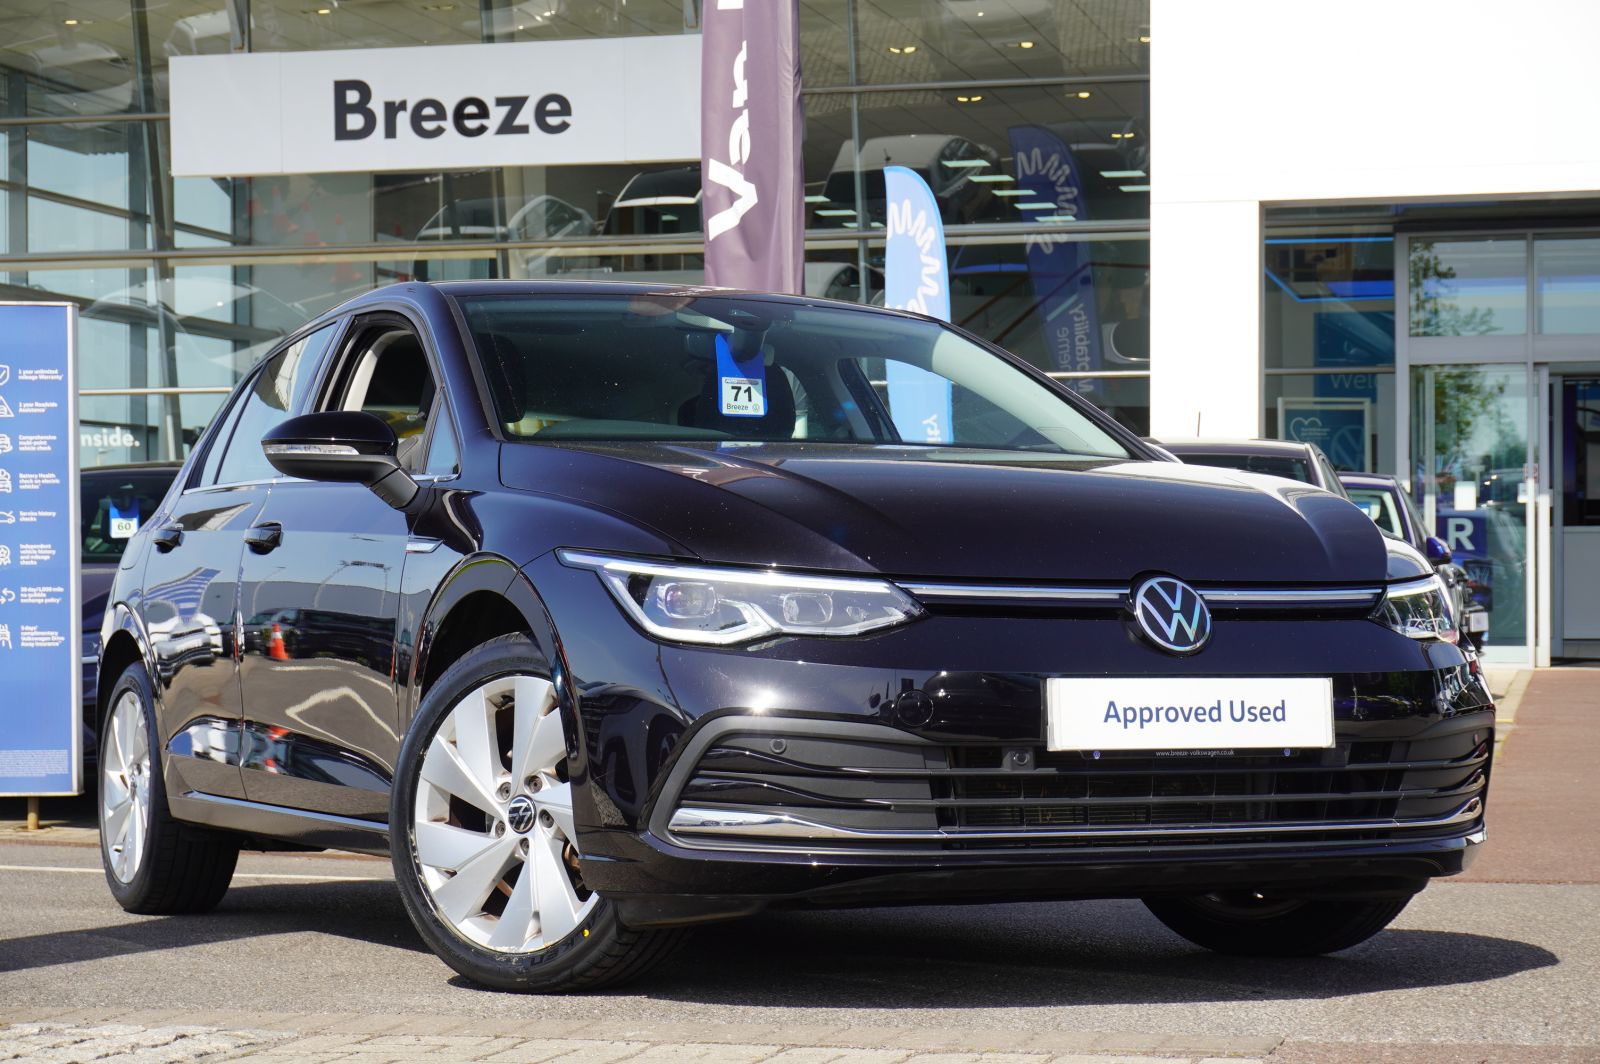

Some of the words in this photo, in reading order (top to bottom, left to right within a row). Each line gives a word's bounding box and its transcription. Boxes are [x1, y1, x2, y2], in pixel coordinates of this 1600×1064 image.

[334, 79, 572, 141] Breeze
[731, 386, 752, 402] 71
[726, 403, 748, 411] Breeze
[80, 426, 140, 448] nside.
[1447, 518, 1476, 550] R
[1104, 700, 1222, 729] Approved
[1228, 700, 1286, 723] Used
[1156, 750, 1235, 758] www.breeze-volkswagen.co.uk
